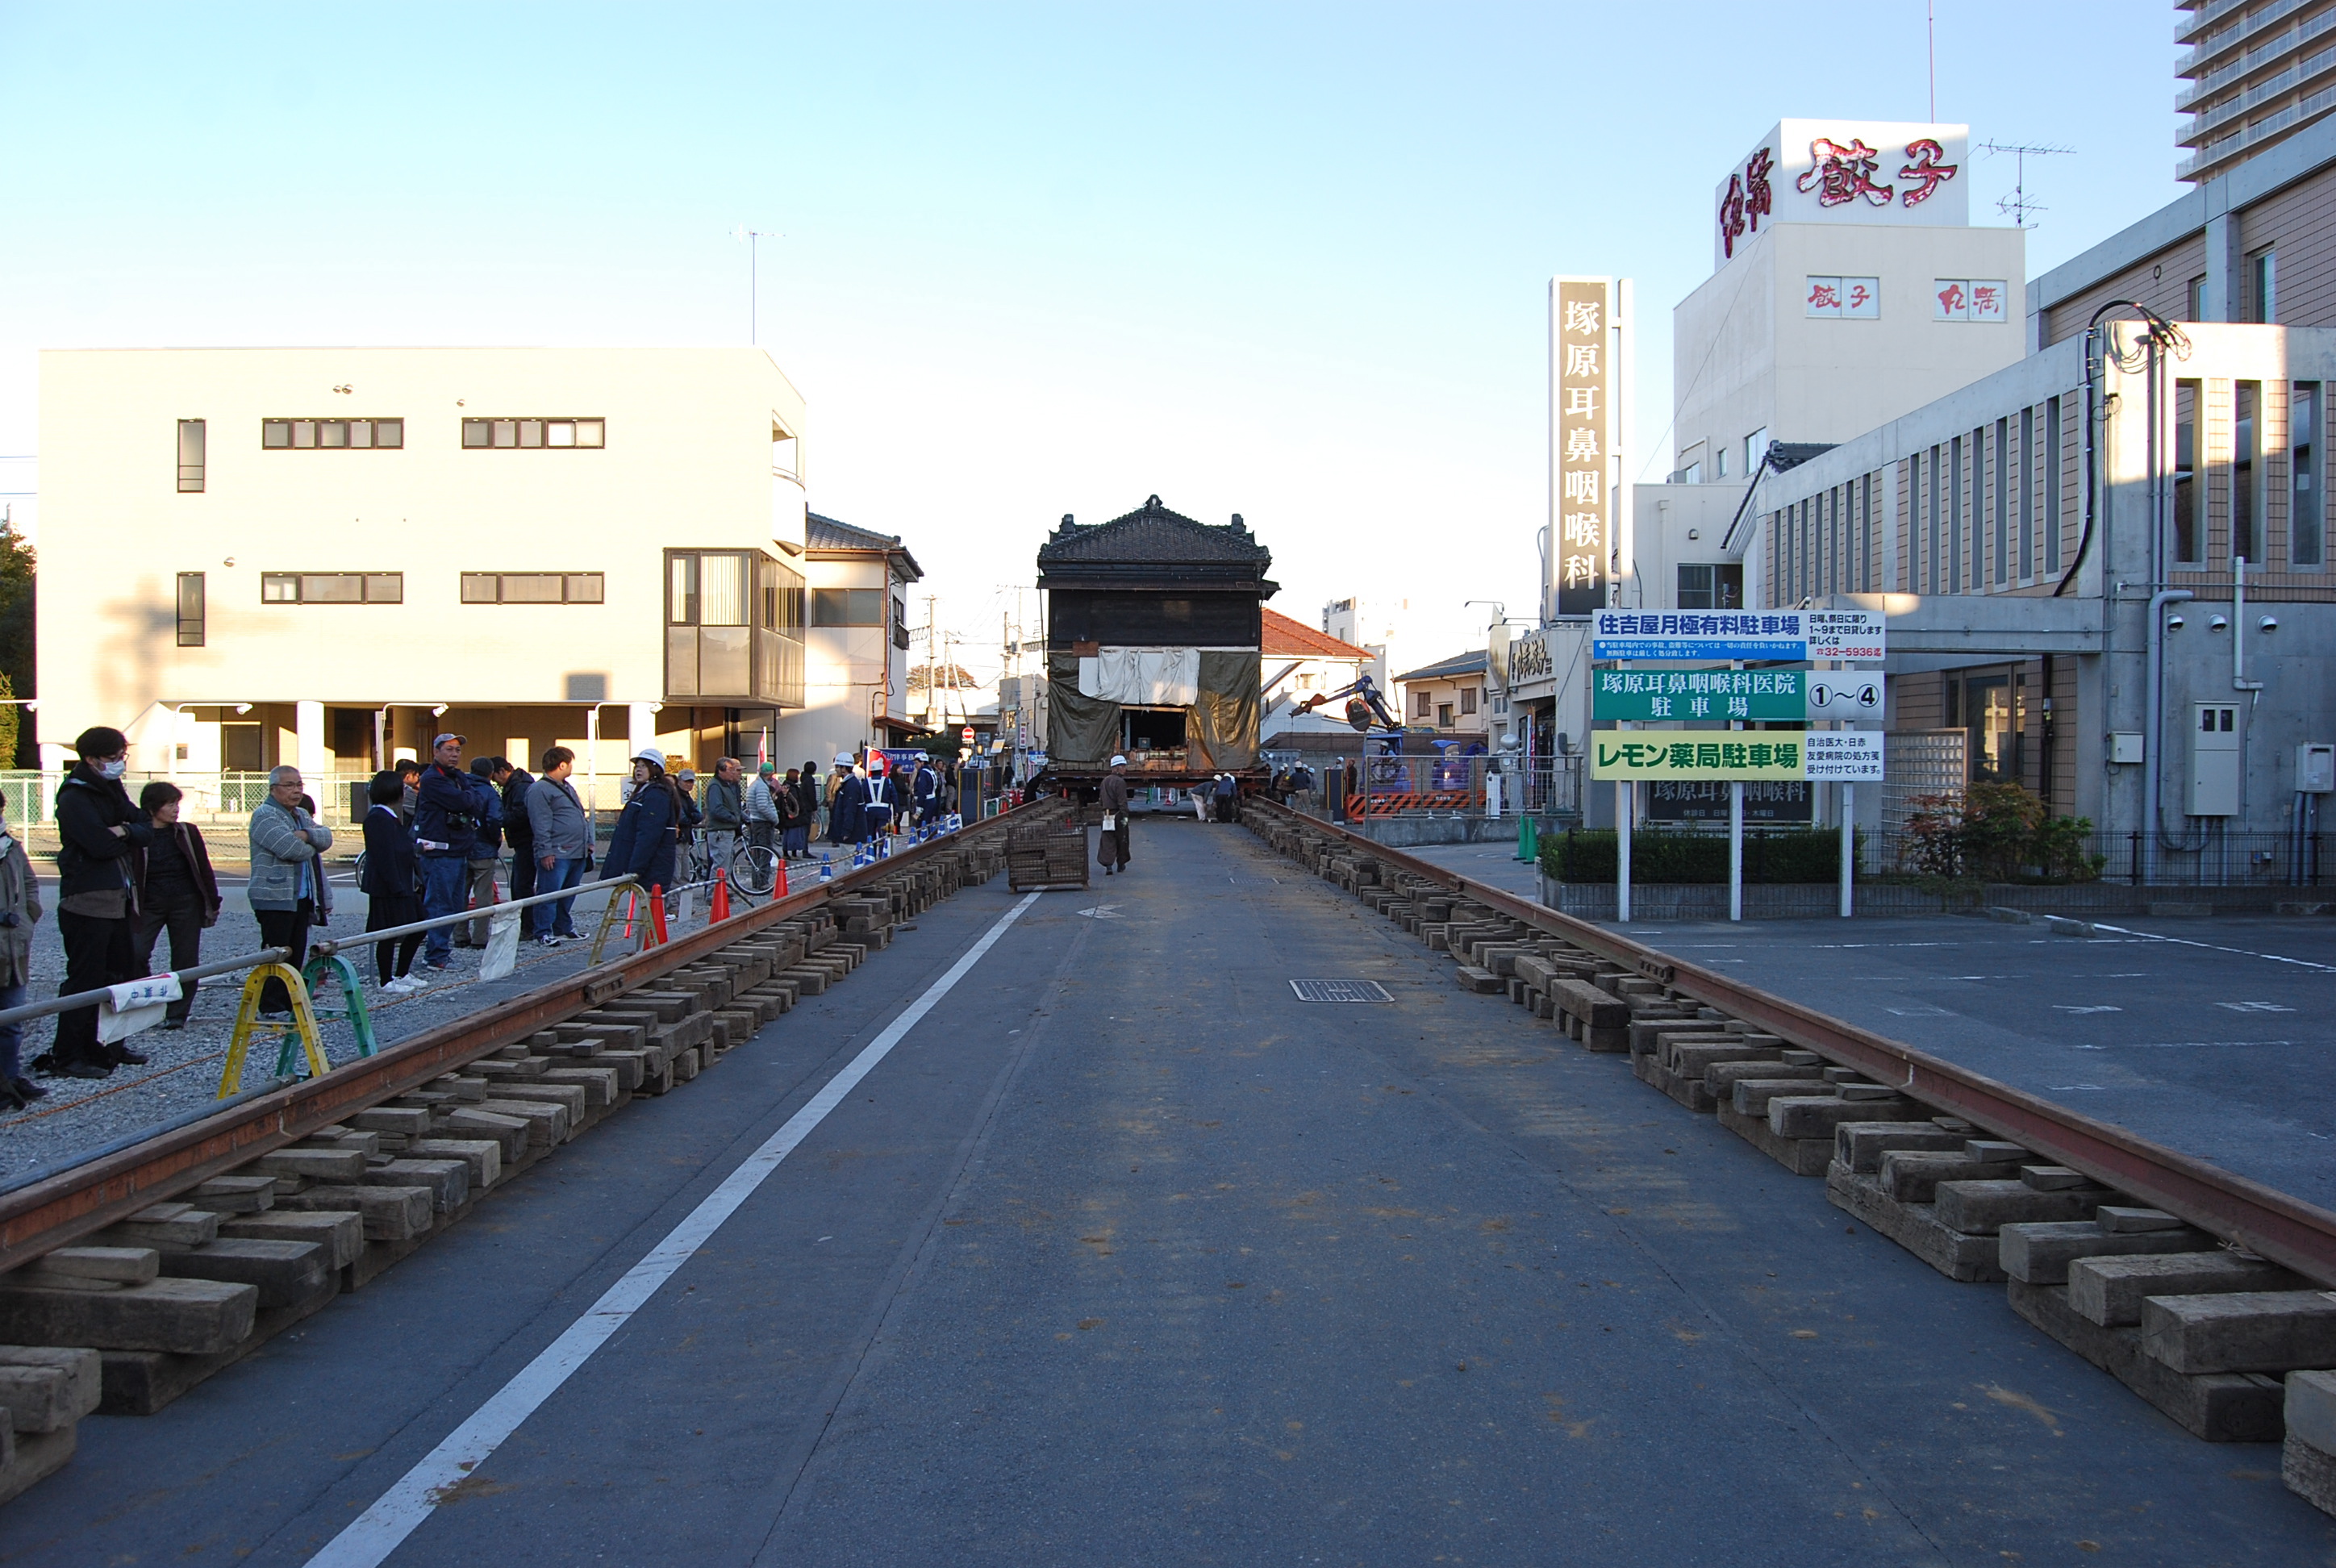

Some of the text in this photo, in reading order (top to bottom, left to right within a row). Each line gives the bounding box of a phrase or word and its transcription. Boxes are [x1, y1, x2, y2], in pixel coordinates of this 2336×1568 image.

[1796, 138, 1958, 207] 餃子
[1808, 285, 1870, 308] 餃子
[1564, 301, 1600, 590] 塚原耳鼻咽喉科
[1598, 615, 1800, 636] 住吉屋月極有料駐車場
[1809, 636, 1840, 645] 詳しくは
[1602, 673, 1796, 694] 塚原耳鼻咽喉科医院
[1651, 697, 1750, 717] 駐車場
[1599, 743, 1798, 769] レモン薬局駐車場
[1807, 765, 1880, 774] 受け付けています。
